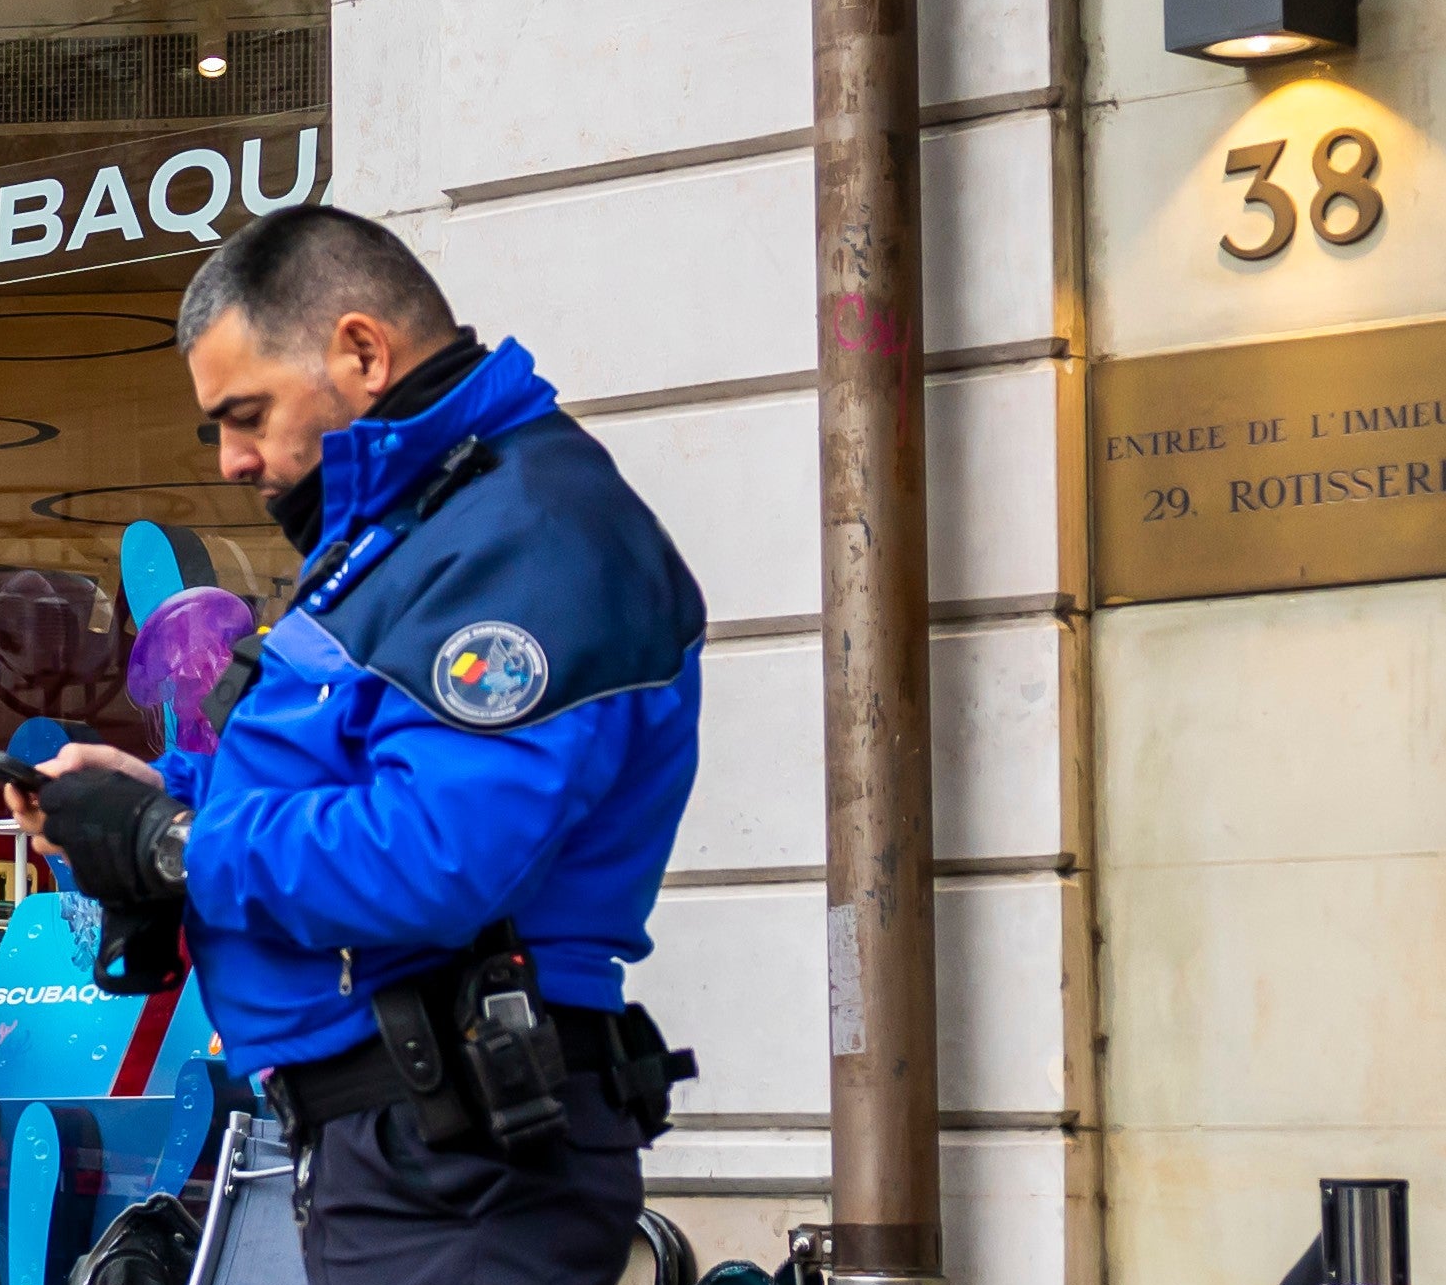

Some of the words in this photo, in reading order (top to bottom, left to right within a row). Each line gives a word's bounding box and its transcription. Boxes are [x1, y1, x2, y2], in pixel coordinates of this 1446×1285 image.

[1220, 127, 1384, 261] 38
[1106, 425, 1227, 462] ENTREE
[1248, 418, 1287, 446] DE
